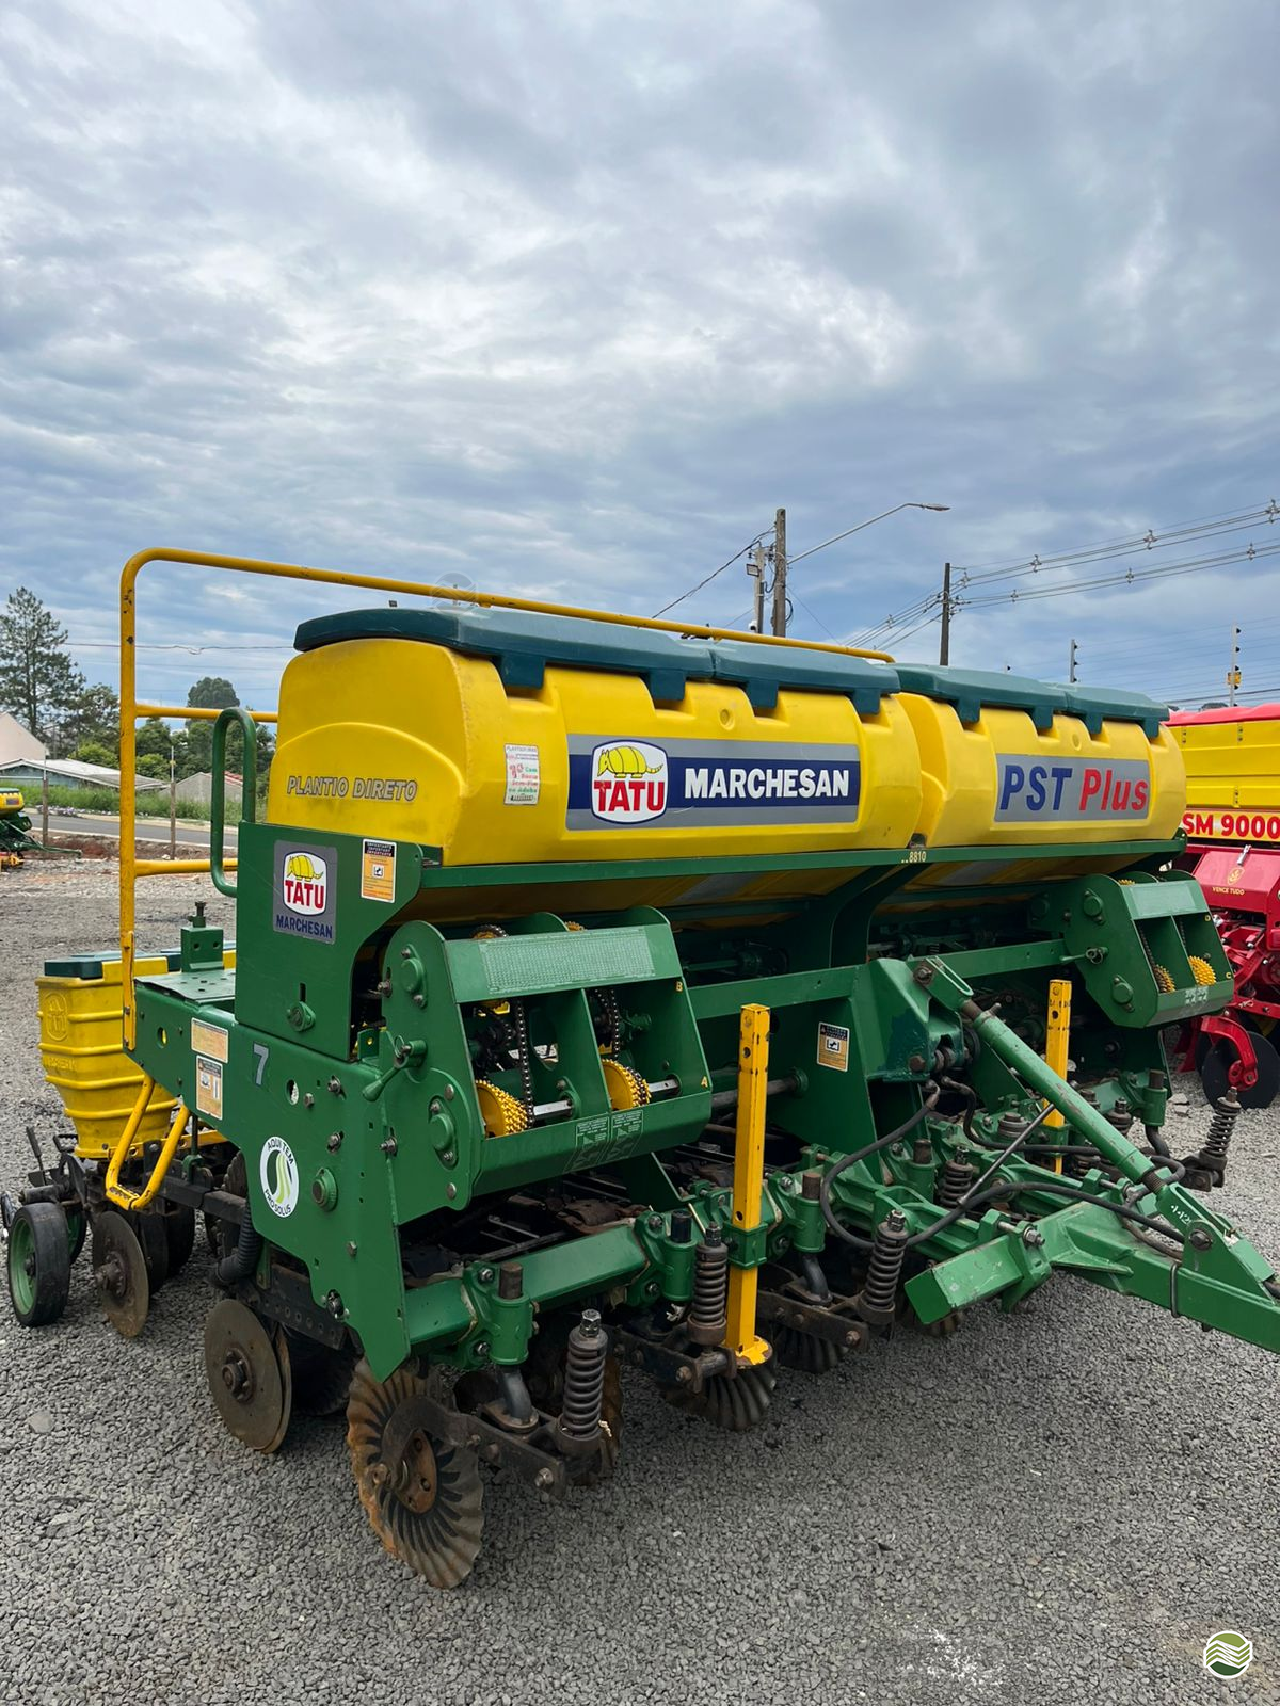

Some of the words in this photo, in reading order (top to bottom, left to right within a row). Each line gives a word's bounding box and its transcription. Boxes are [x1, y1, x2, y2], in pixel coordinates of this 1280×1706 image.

[287, 775, 349, 796] PLANTIO
[352, 777, 418, 801] DIRETO
[593, 779, 665, 812] TATU
[684, 768, 849, 799] MARCHESAN
[999, 765, 1072, 811] PST
[1078, 767, 1149, 811] Plus
[1182, 813, 1214, 836] SM
[1220, 814, 1280, 839] 9000
[285, 880, 325, 909] TATU
[1212, 886, 1229, 895] VENCE
[1230, 888, 1245, 896] TUDO
[276, 914, 333, 939] MARCHESAN
[675, 981, 683, 992] B
[253, 1043, 269, 1087] 7
[700, 1075, 708, 1088] A
[282, 1141, 295, 1165] TEM
